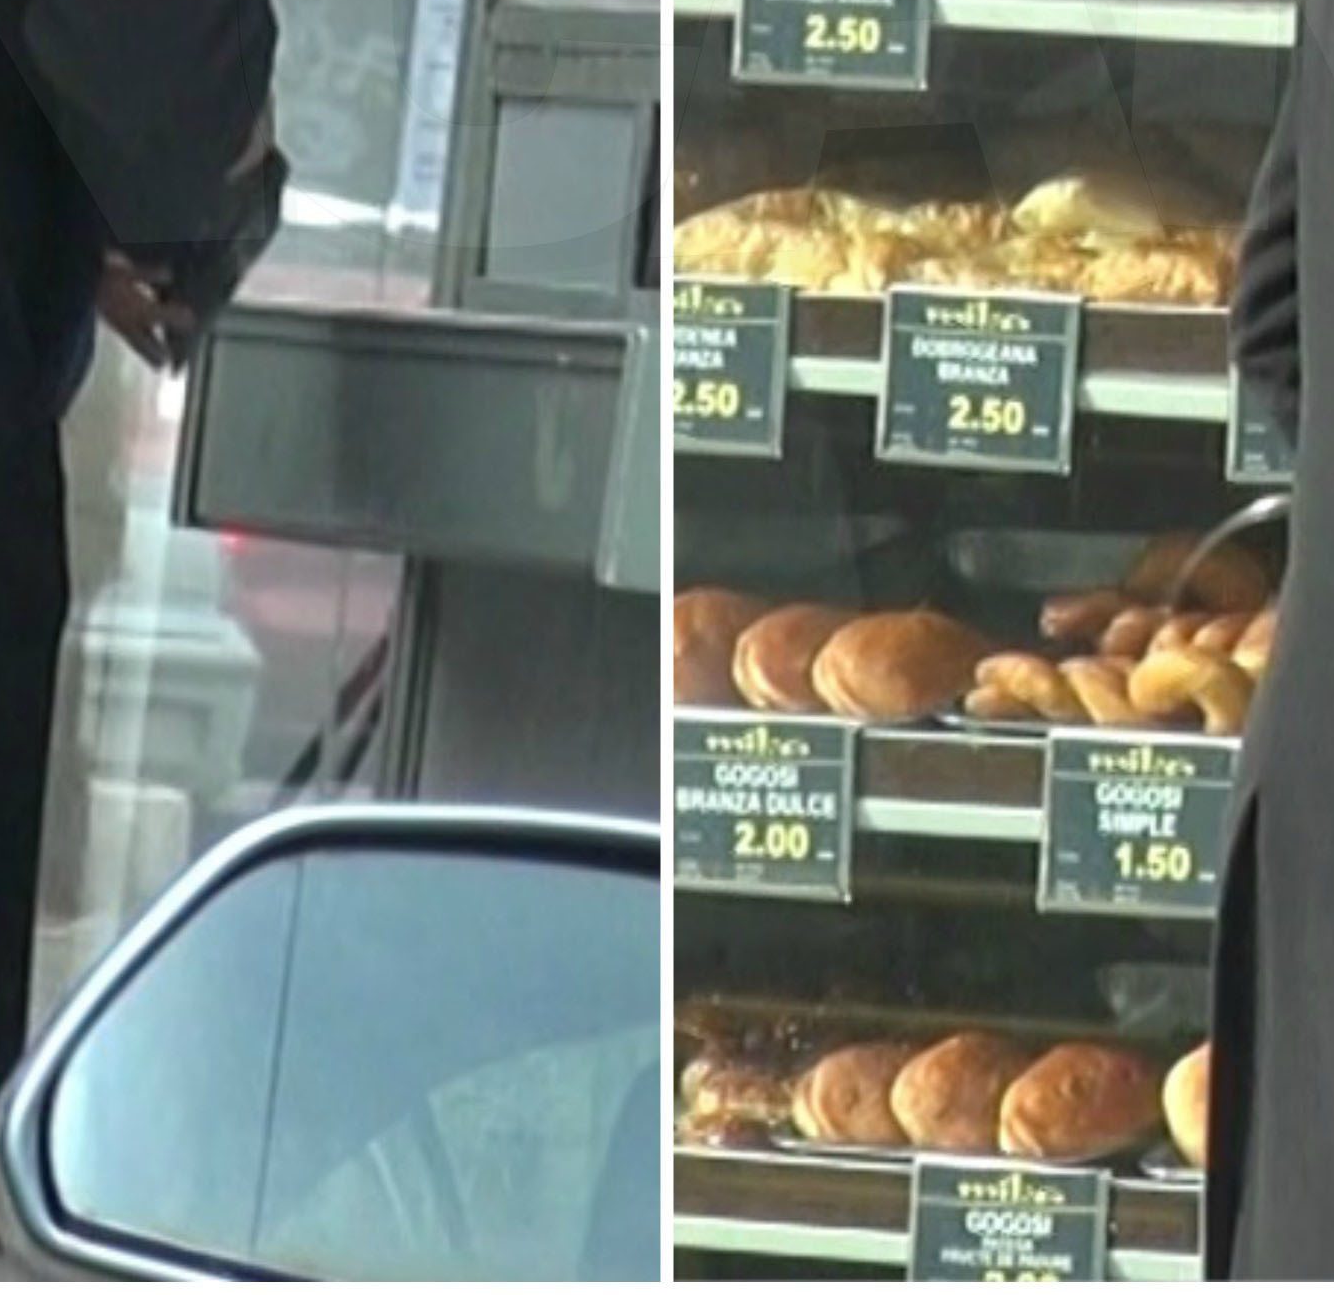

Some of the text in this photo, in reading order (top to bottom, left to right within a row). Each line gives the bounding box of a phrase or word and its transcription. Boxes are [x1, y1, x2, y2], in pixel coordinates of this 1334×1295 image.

[804, 13, 882, 54] 2.50
[948, 394, 1025, 435] 2.50
[714, 763, 799, 788] GOGOSI
[675, 787, 837, 819] BRANZA DULCE
[1094, 782, 1183, 810] GOGOSI
[1097, 809, 1178, 837] SIMPLE
[733, 820, 810, 861] 2.00
[1114, 841, 1191, 882] 1.50
[964, 1210, 1054, 1238] GOGOSI
